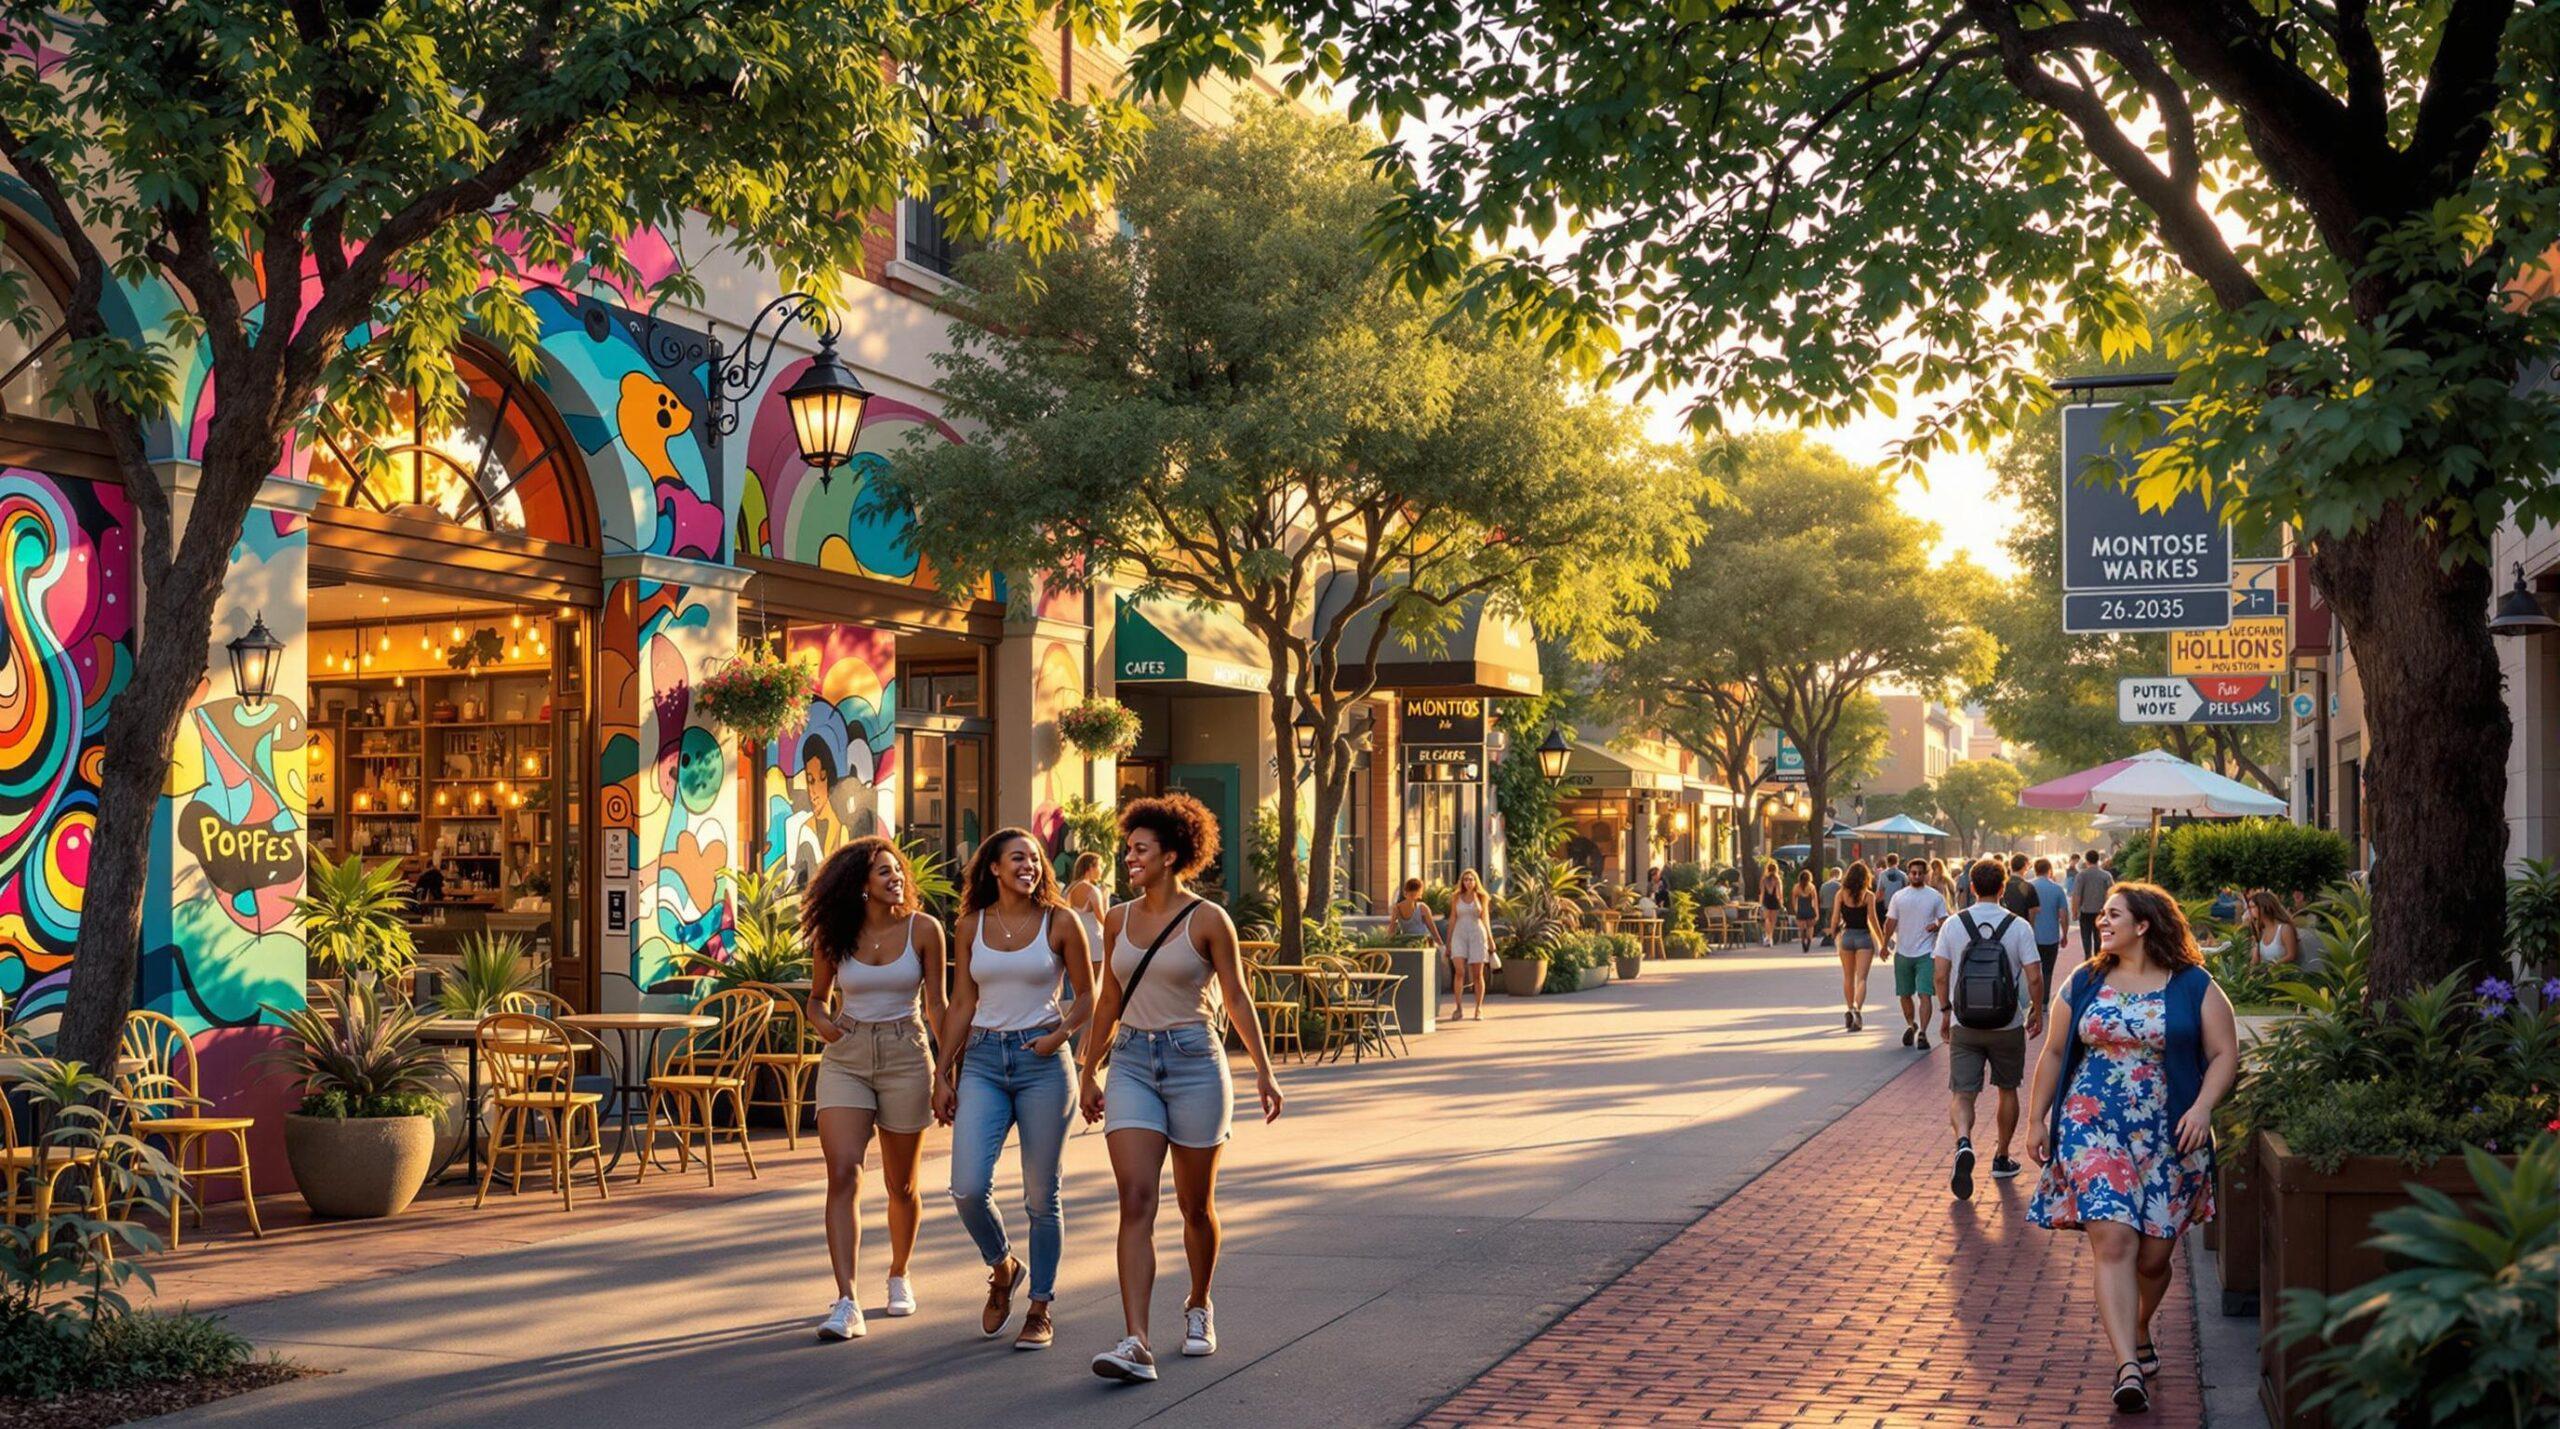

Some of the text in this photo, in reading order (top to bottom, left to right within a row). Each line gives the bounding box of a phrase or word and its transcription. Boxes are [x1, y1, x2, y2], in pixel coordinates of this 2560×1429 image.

[2092, 534, 2208, 557] MONTOSE
[2103, 559, 2199, 580] WARKES
[2101, 599, 2184, 620] 26.2035
[2177, 639, 2283, 660] HOLLIONS
